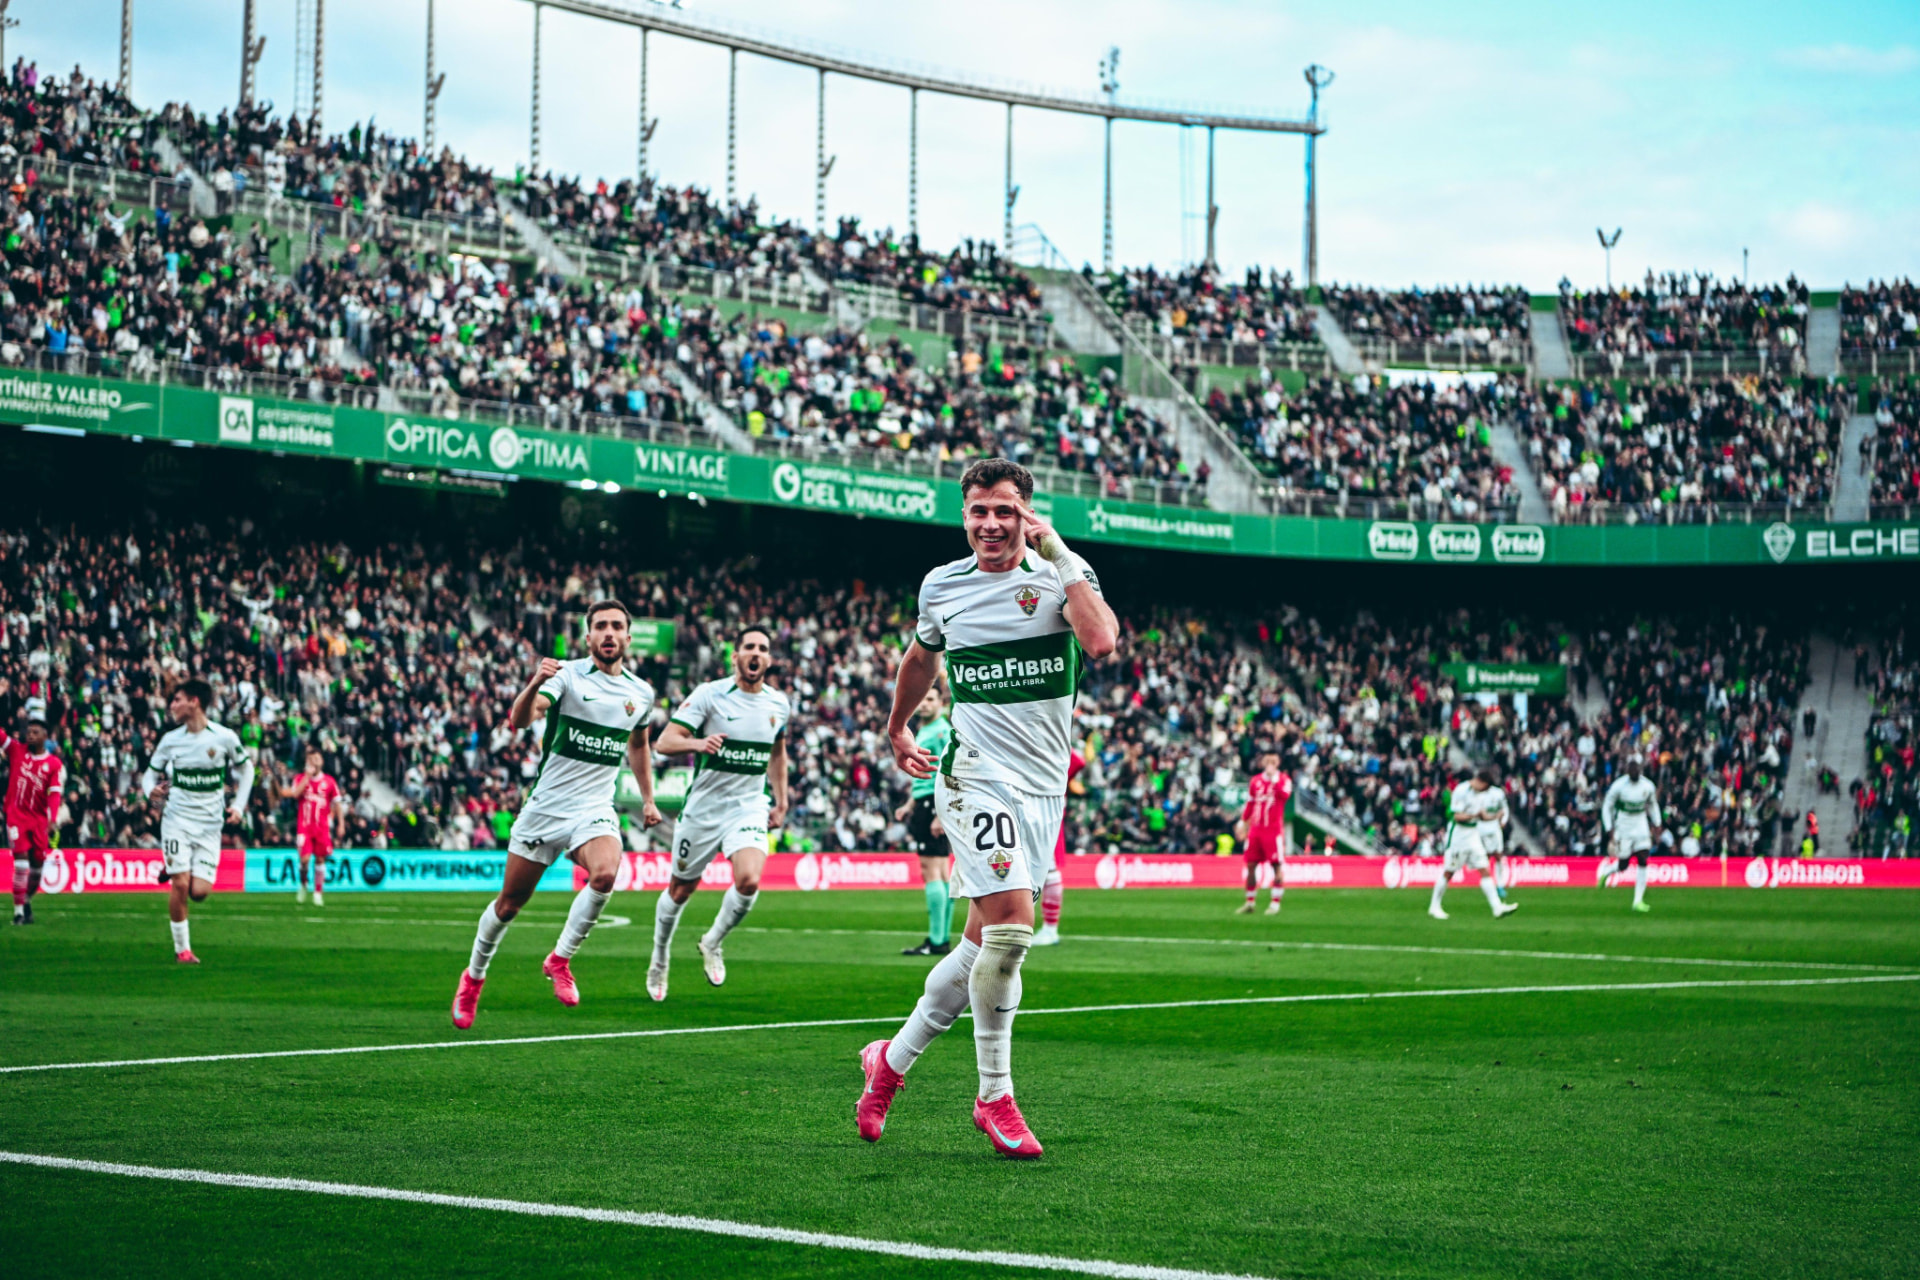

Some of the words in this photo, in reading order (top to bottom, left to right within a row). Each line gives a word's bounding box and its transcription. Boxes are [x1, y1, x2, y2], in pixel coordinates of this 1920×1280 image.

[0, 397, 110, 421] VINGUTS/WELCOME
[57, 385, 122, 408] VALERO
[257, 421, 333, 447] abatibles
[635, 446, 729, 482] VINTAGE
[802, 480, 841, 507] DEL
[1806, 527, 1920, 557] ELCHE
[982, 682, 997, 690] REY
[1022, 678, 1046, 686] FIBRA
[973, 812, 1016, 851] 20
[678, 838, 691, 858] 6
[71, 851, 164, 893] johns
[390, 860, 506, 879] HYPERMOT
[818, 855, 910, 890] johnson
[1769, 858, 1865, 888] johnson
